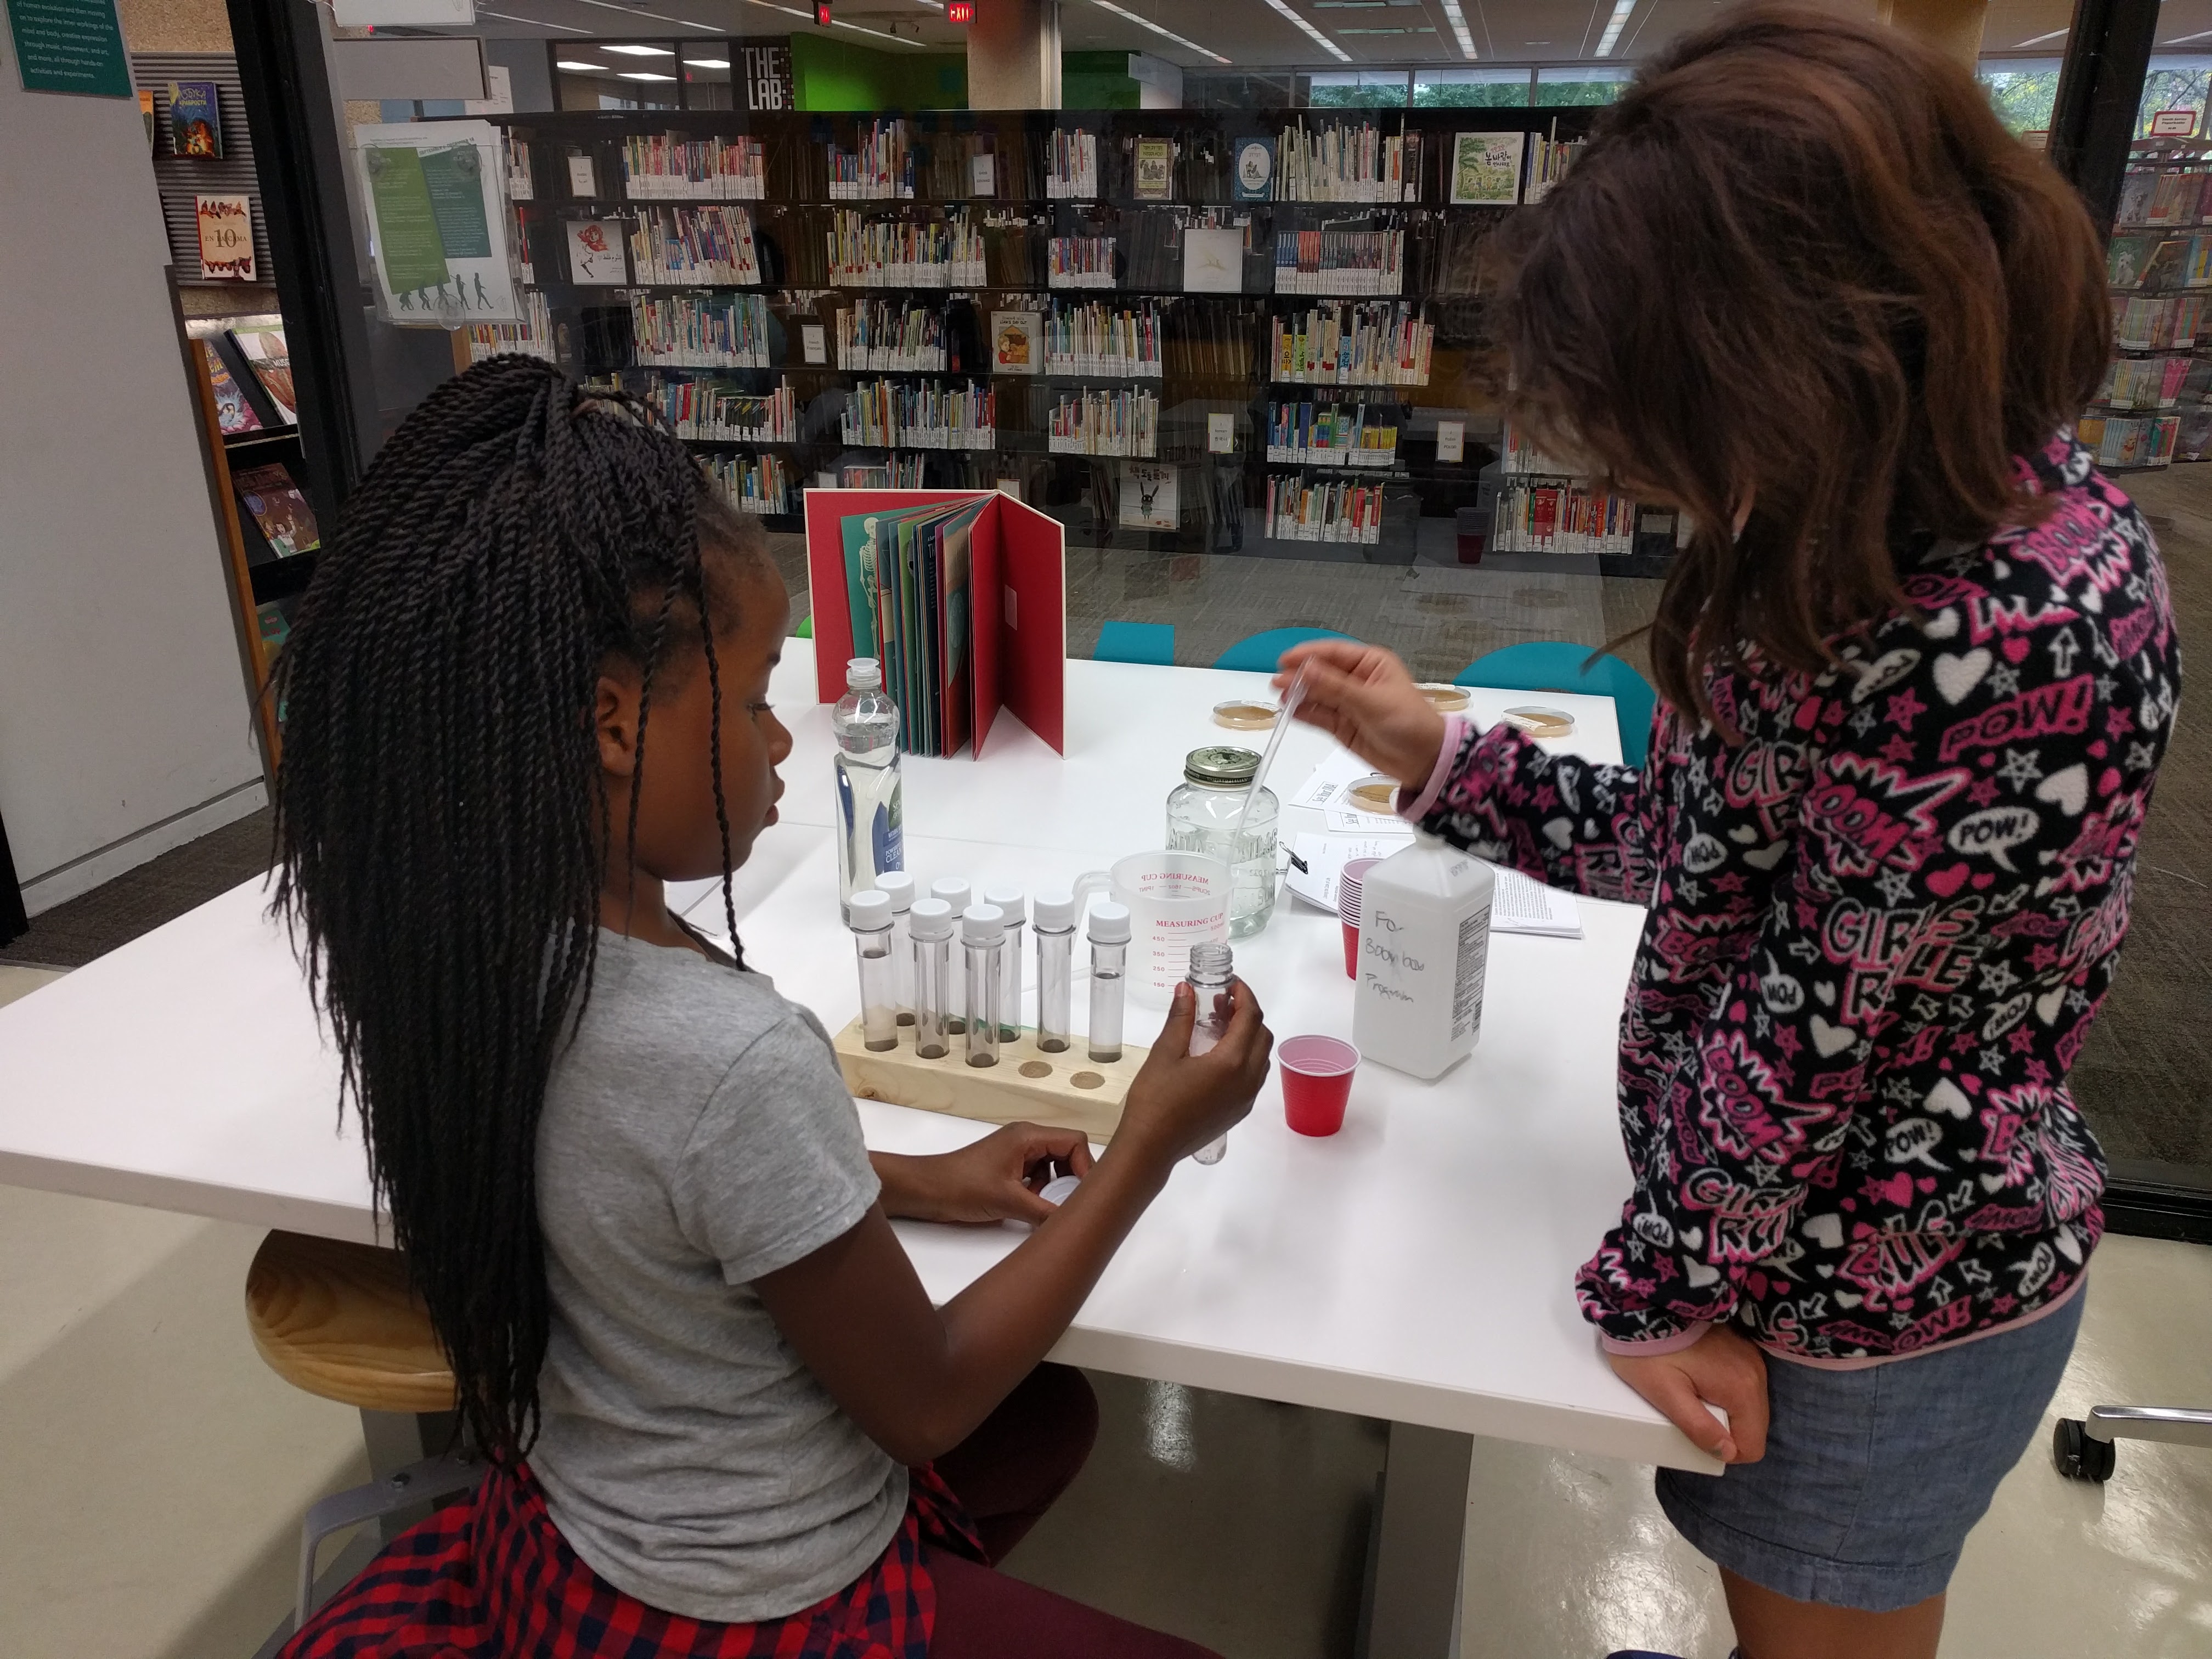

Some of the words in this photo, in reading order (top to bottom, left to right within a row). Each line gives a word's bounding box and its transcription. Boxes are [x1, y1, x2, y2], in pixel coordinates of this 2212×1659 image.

[950, 3, 970, 21] EXIT
[741, 47, 781, 78] THE
[748, 79, 782, 110] LAB
[214, 229, 237, 248] 10
[1945, 680, 2091, 745] POW!
[1957, 812, 2029, 846] POW!
[1155, 918, 1209, 928] MEASURING
[1210, 912, 1224, 923] CUP
[1707, 1046, 1784, 1148] BOOM
